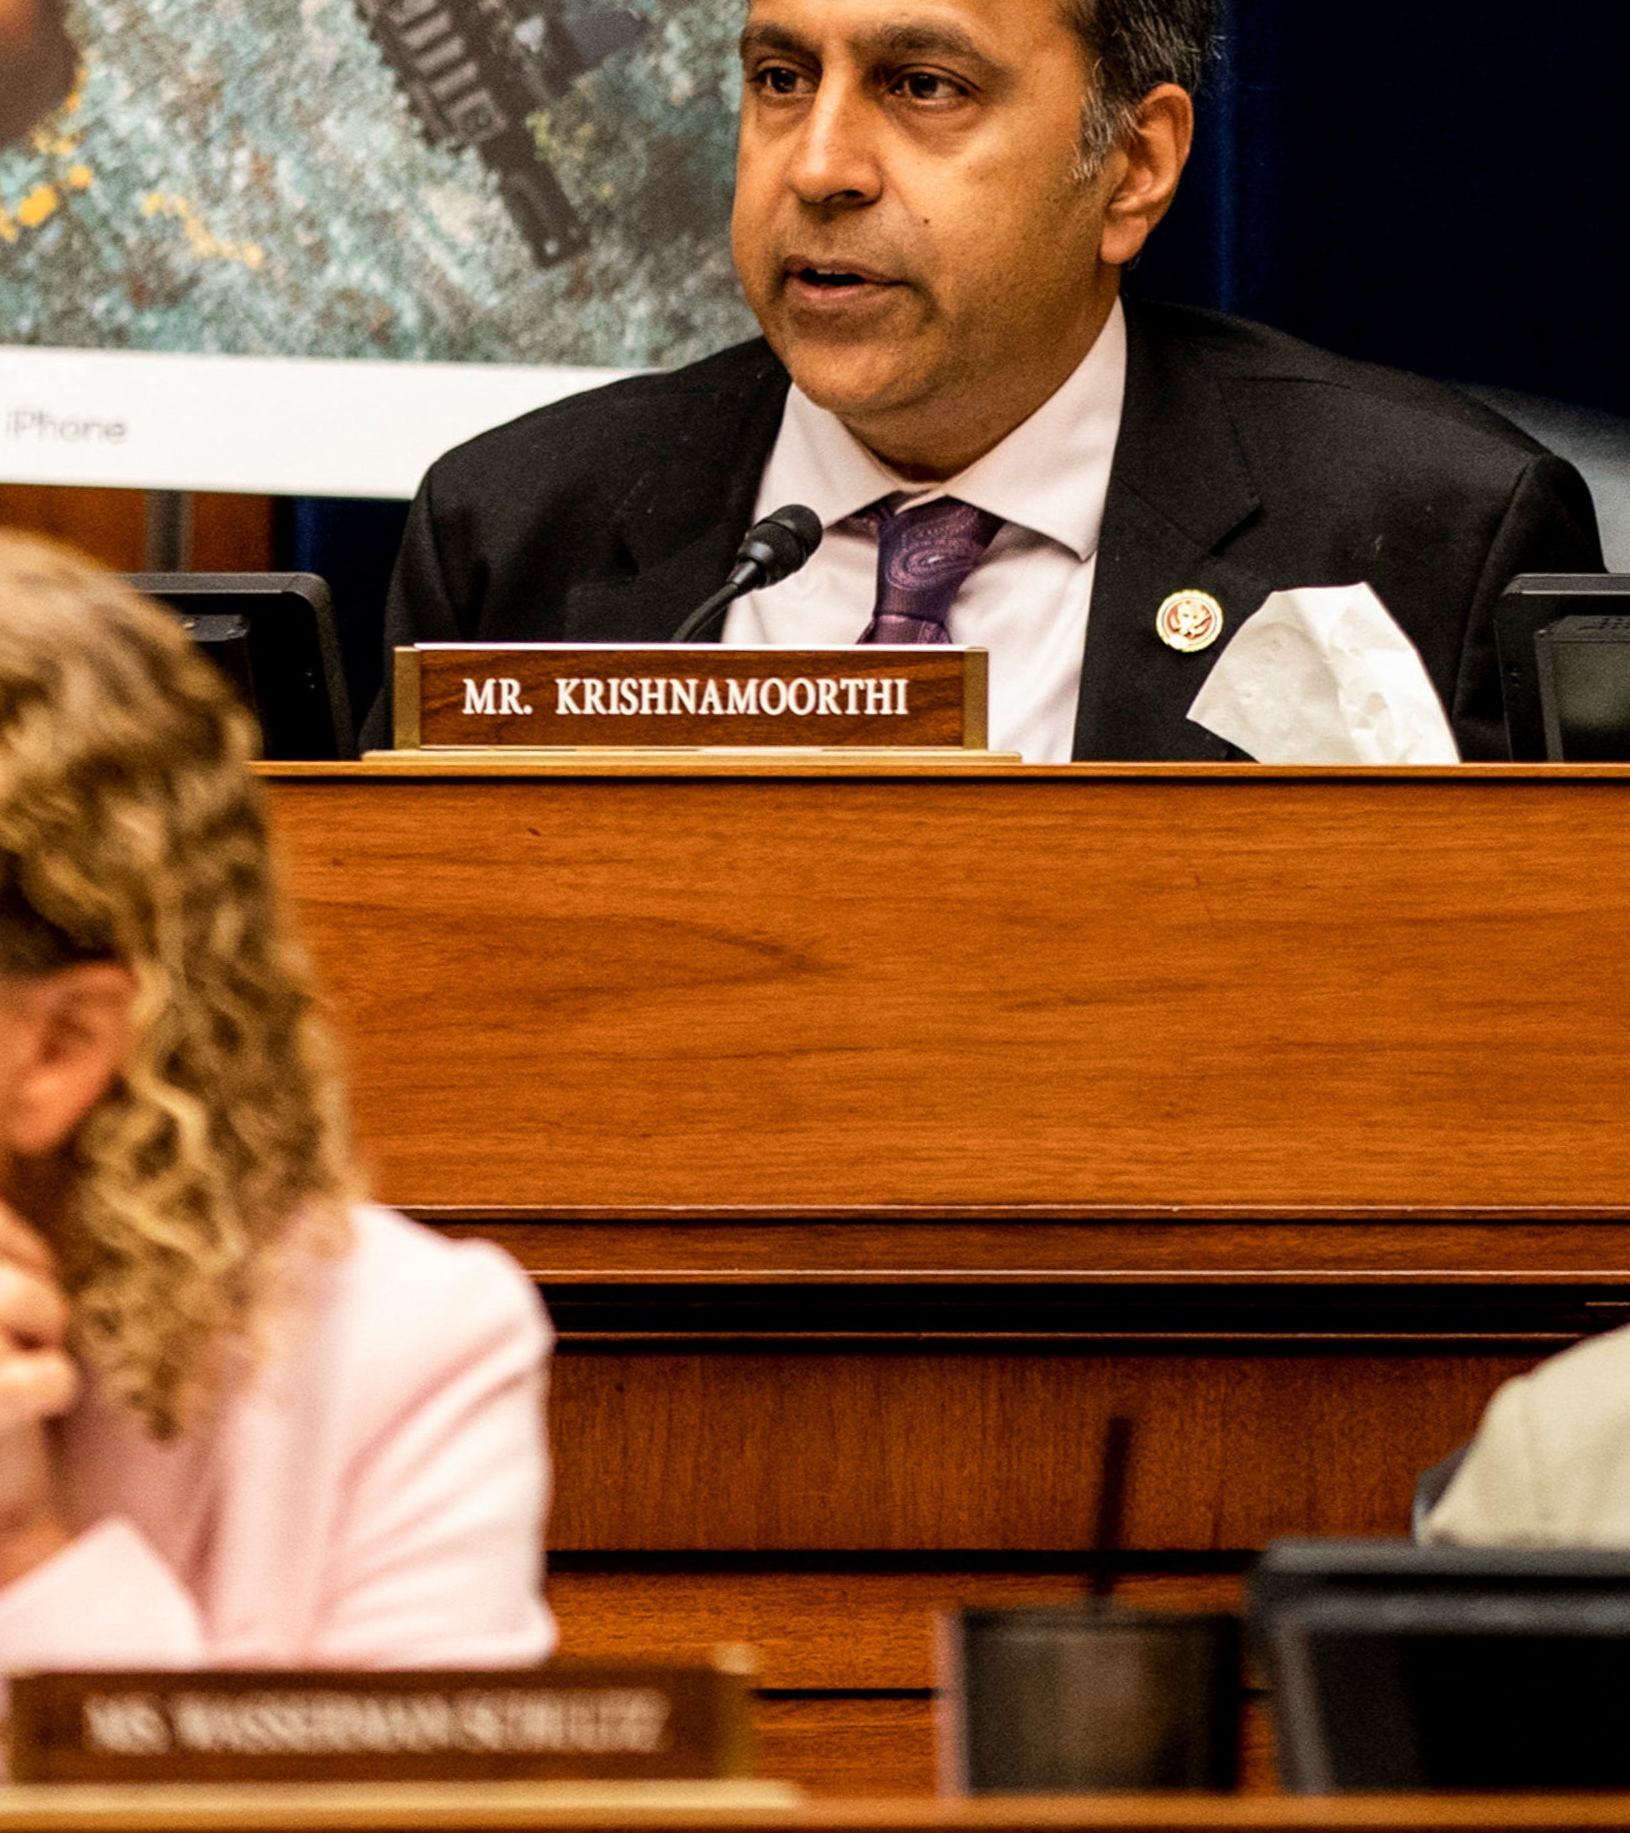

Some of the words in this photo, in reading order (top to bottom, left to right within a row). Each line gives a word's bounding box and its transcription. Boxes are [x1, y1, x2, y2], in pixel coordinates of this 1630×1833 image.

[5, 407, 129, 446] iPhone
[461, 676, 534, 716] MR.
[554, 676, 910, 716] KRISHNAMOORTHI
